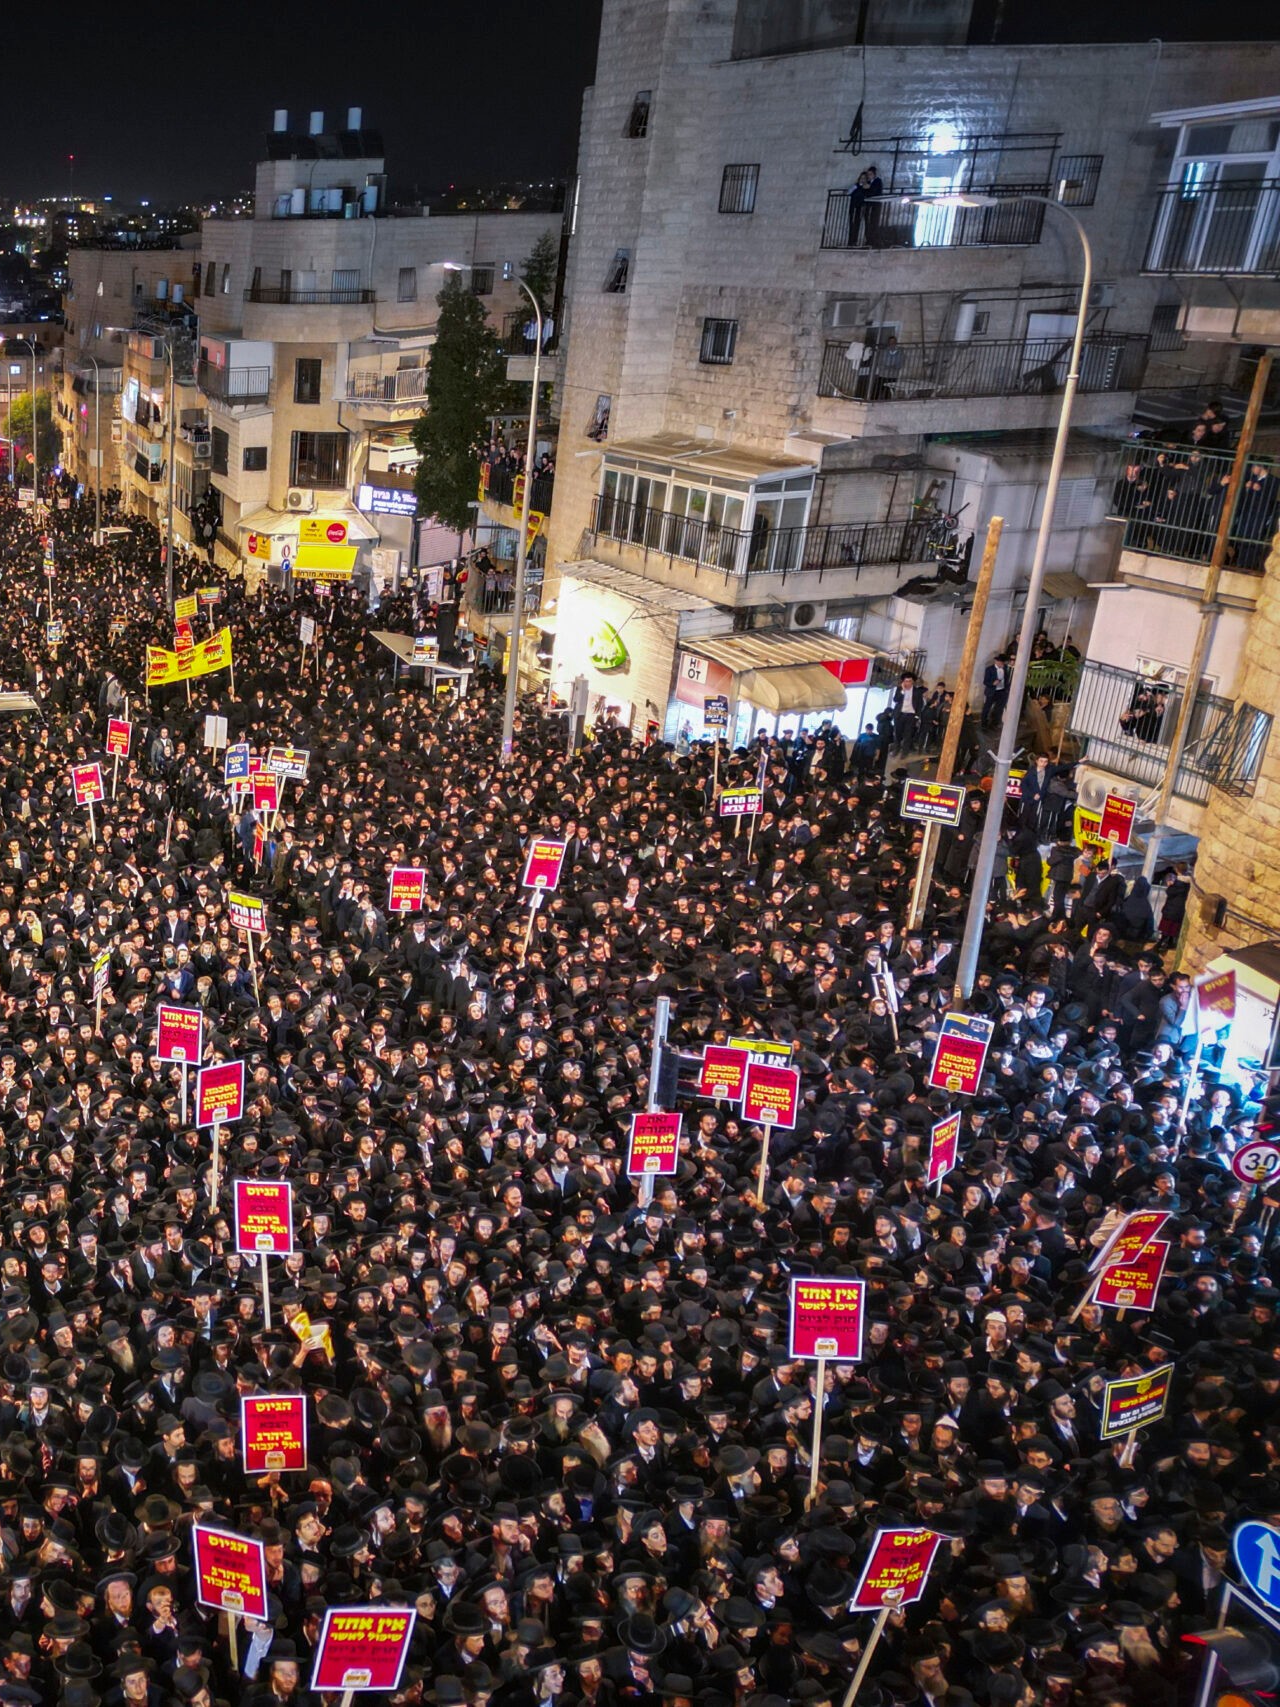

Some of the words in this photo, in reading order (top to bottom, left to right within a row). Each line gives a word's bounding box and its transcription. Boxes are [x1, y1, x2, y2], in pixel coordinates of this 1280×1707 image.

[723, 796, 746, 804] חרדי
[748, 795, 760, 803] או
[724, 805, 745, 813] צבא
[746, 804, 759, 812] או
[161, 1011, 183, 1021] אחד
[183, 1013, 199, 1024] אין
[768, 1054, 787, 1066] או
[205, 1082, 237, 1096] הסכמה
[203, 1090, 239, 1104] להחרבת
[203, 1098, 237, 1111] היהדות
[634, 1135, 658, 1145] תהא
[659, 1133, 675, 1143] לא
[633, 1145, 674, 1155] מופקרת
[1245, 1153, 1278, 1171] 30
[246, 1186, 279, 1197] הגיוס
[247, 1215, 280, 1224] ביהרג
[240, 1224, 268, 1234] יעבור
[270, 1225, 288, 1234] ואל
[1114, 1270, 1148, 1281] ביהרג
[798, 1287, 832, 1300] אחד
[835, 1289, 858, 1302] אין
[798, 1301, 826, 1310] לאשר
[828, 1302, 858, 1311] שיכול
[255, 1402, 292, 1412] הגיוס
[256, 1431, 293, 1441] ביהרג
[249, 1442, 279, 1451] יעבור
[281, 1441, 301, 1450] ואל
[208, 1534, 248, 1554] הגיוס
[893, 1531, 933, 1547] הגיוס
[211, 1566, 251, 1584] ביהרג
[880, 1562, 921, 1578] ביהרג
[202, 1573, 236, 1590] יעבור
[906, 1570, 924, 1584] ואל
[238, 1581, 261, 1597] ואל
[866, 1579, 904, 1589] יעבור
[333, 1617, 374, 1631] אחד
[378, 1618, 407, 1633] אין
[330, 1632, 364, 1642] לאשר
[367, 1632, 403, 1642] שיכול
